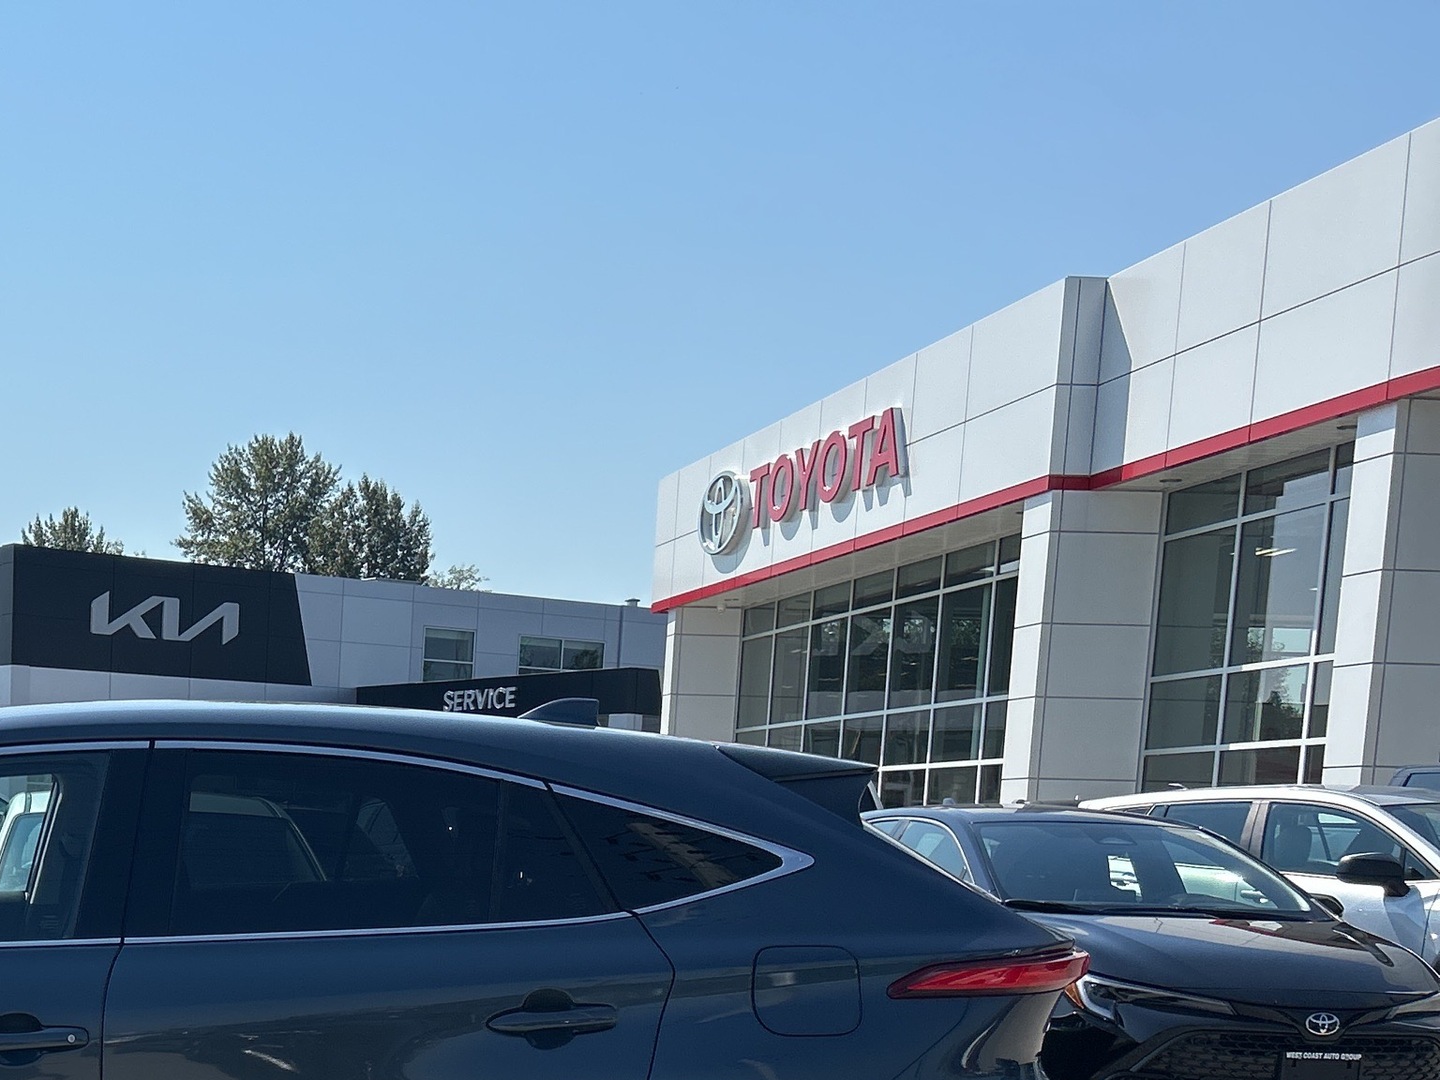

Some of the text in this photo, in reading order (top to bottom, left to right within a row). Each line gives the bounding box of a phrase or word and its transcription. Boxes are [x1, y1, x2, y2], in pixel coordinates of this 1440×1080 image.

[749, 407, 904, 530] TOYOTA
[90, 591, 240, 645] KIA
[443, 686, 517, 712] SERVICE
[1286, 1051, 1302, 1059] WEST
[1303, 1052, 1323, 1060] COAST
[1340, 1053, 1362, 1061] GROUP
